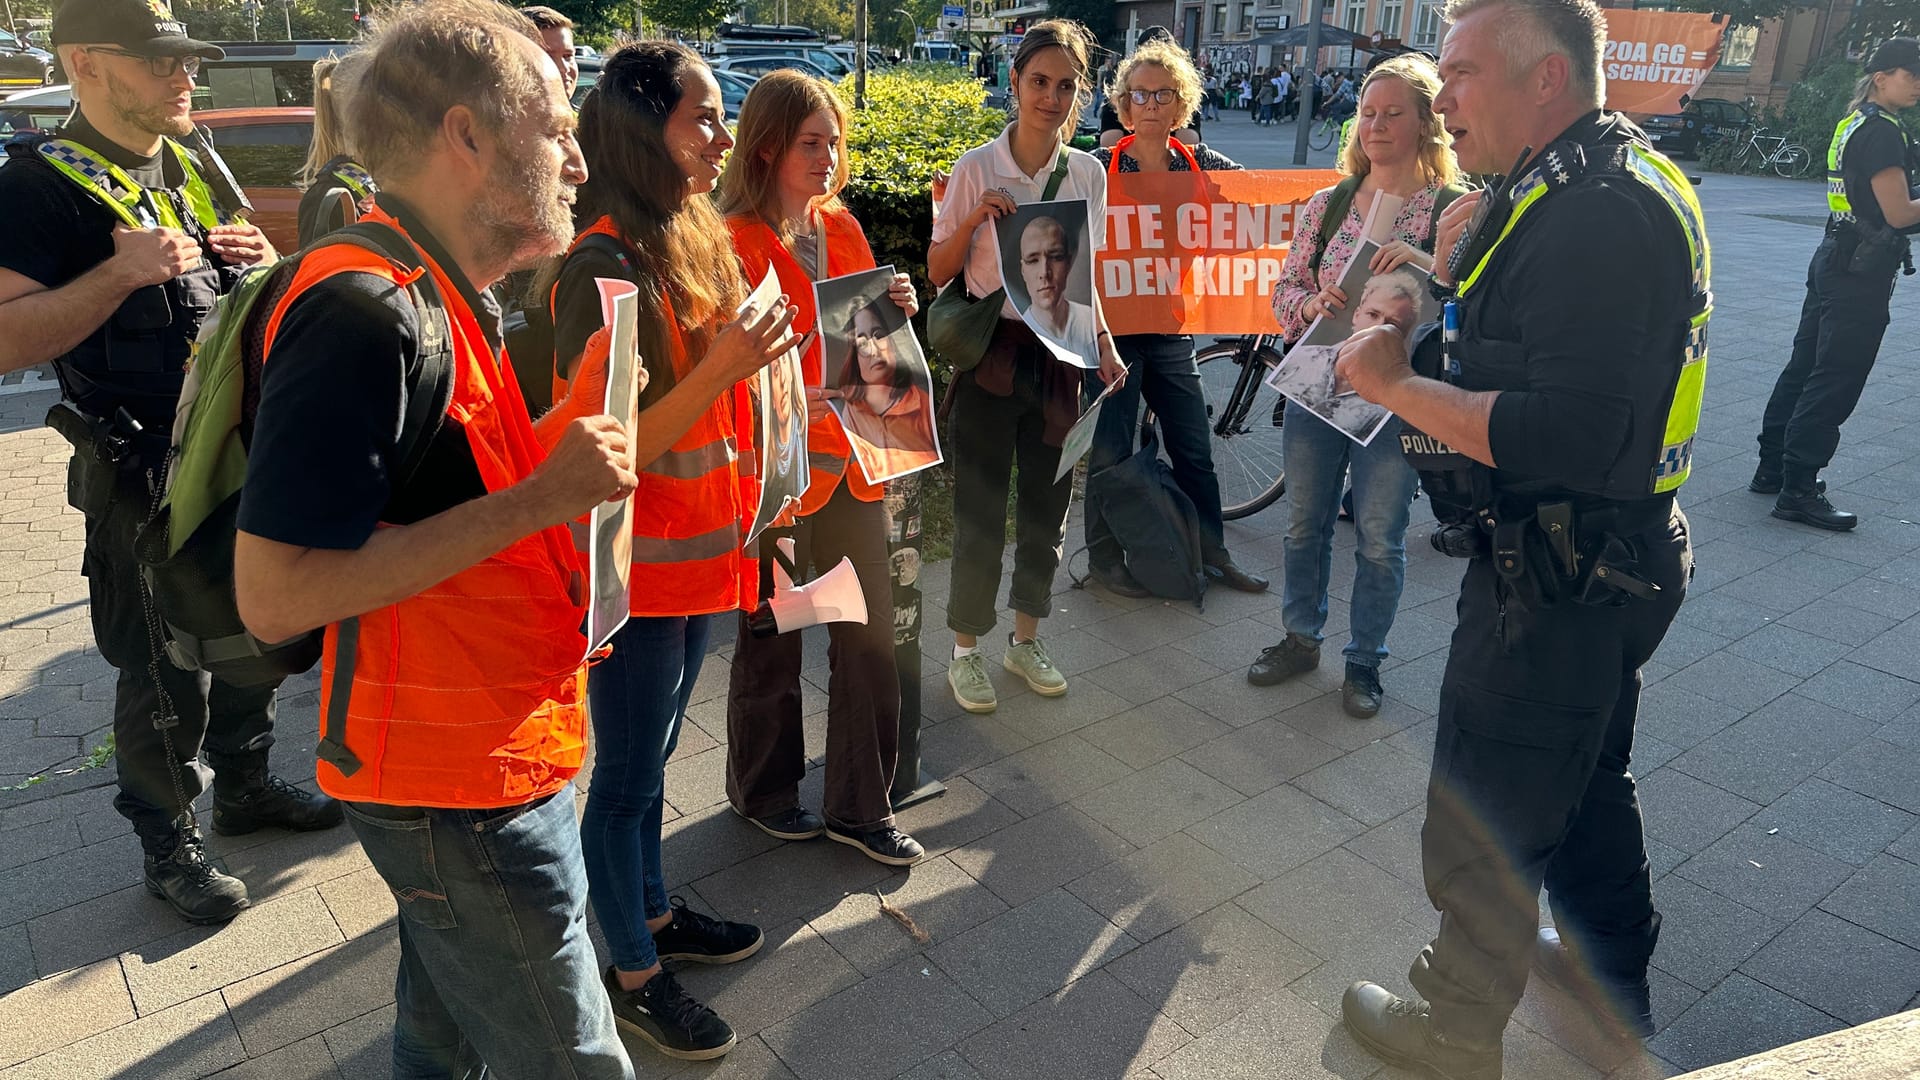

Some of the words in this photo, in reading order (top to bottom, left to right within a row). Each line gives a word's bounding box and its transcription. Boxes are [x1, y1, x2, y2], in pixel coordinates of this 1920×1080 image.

[1652, 43, 1687, 65] GG
[1691, 51, 1707, 60] =
[1606, 62, 1707, 85] SCHÜTZEN
[1106, 204, 1165, 250] TE
[1102, 257, 1182, 298] DEN
[1192, 256, 1287, 296] KIPP
